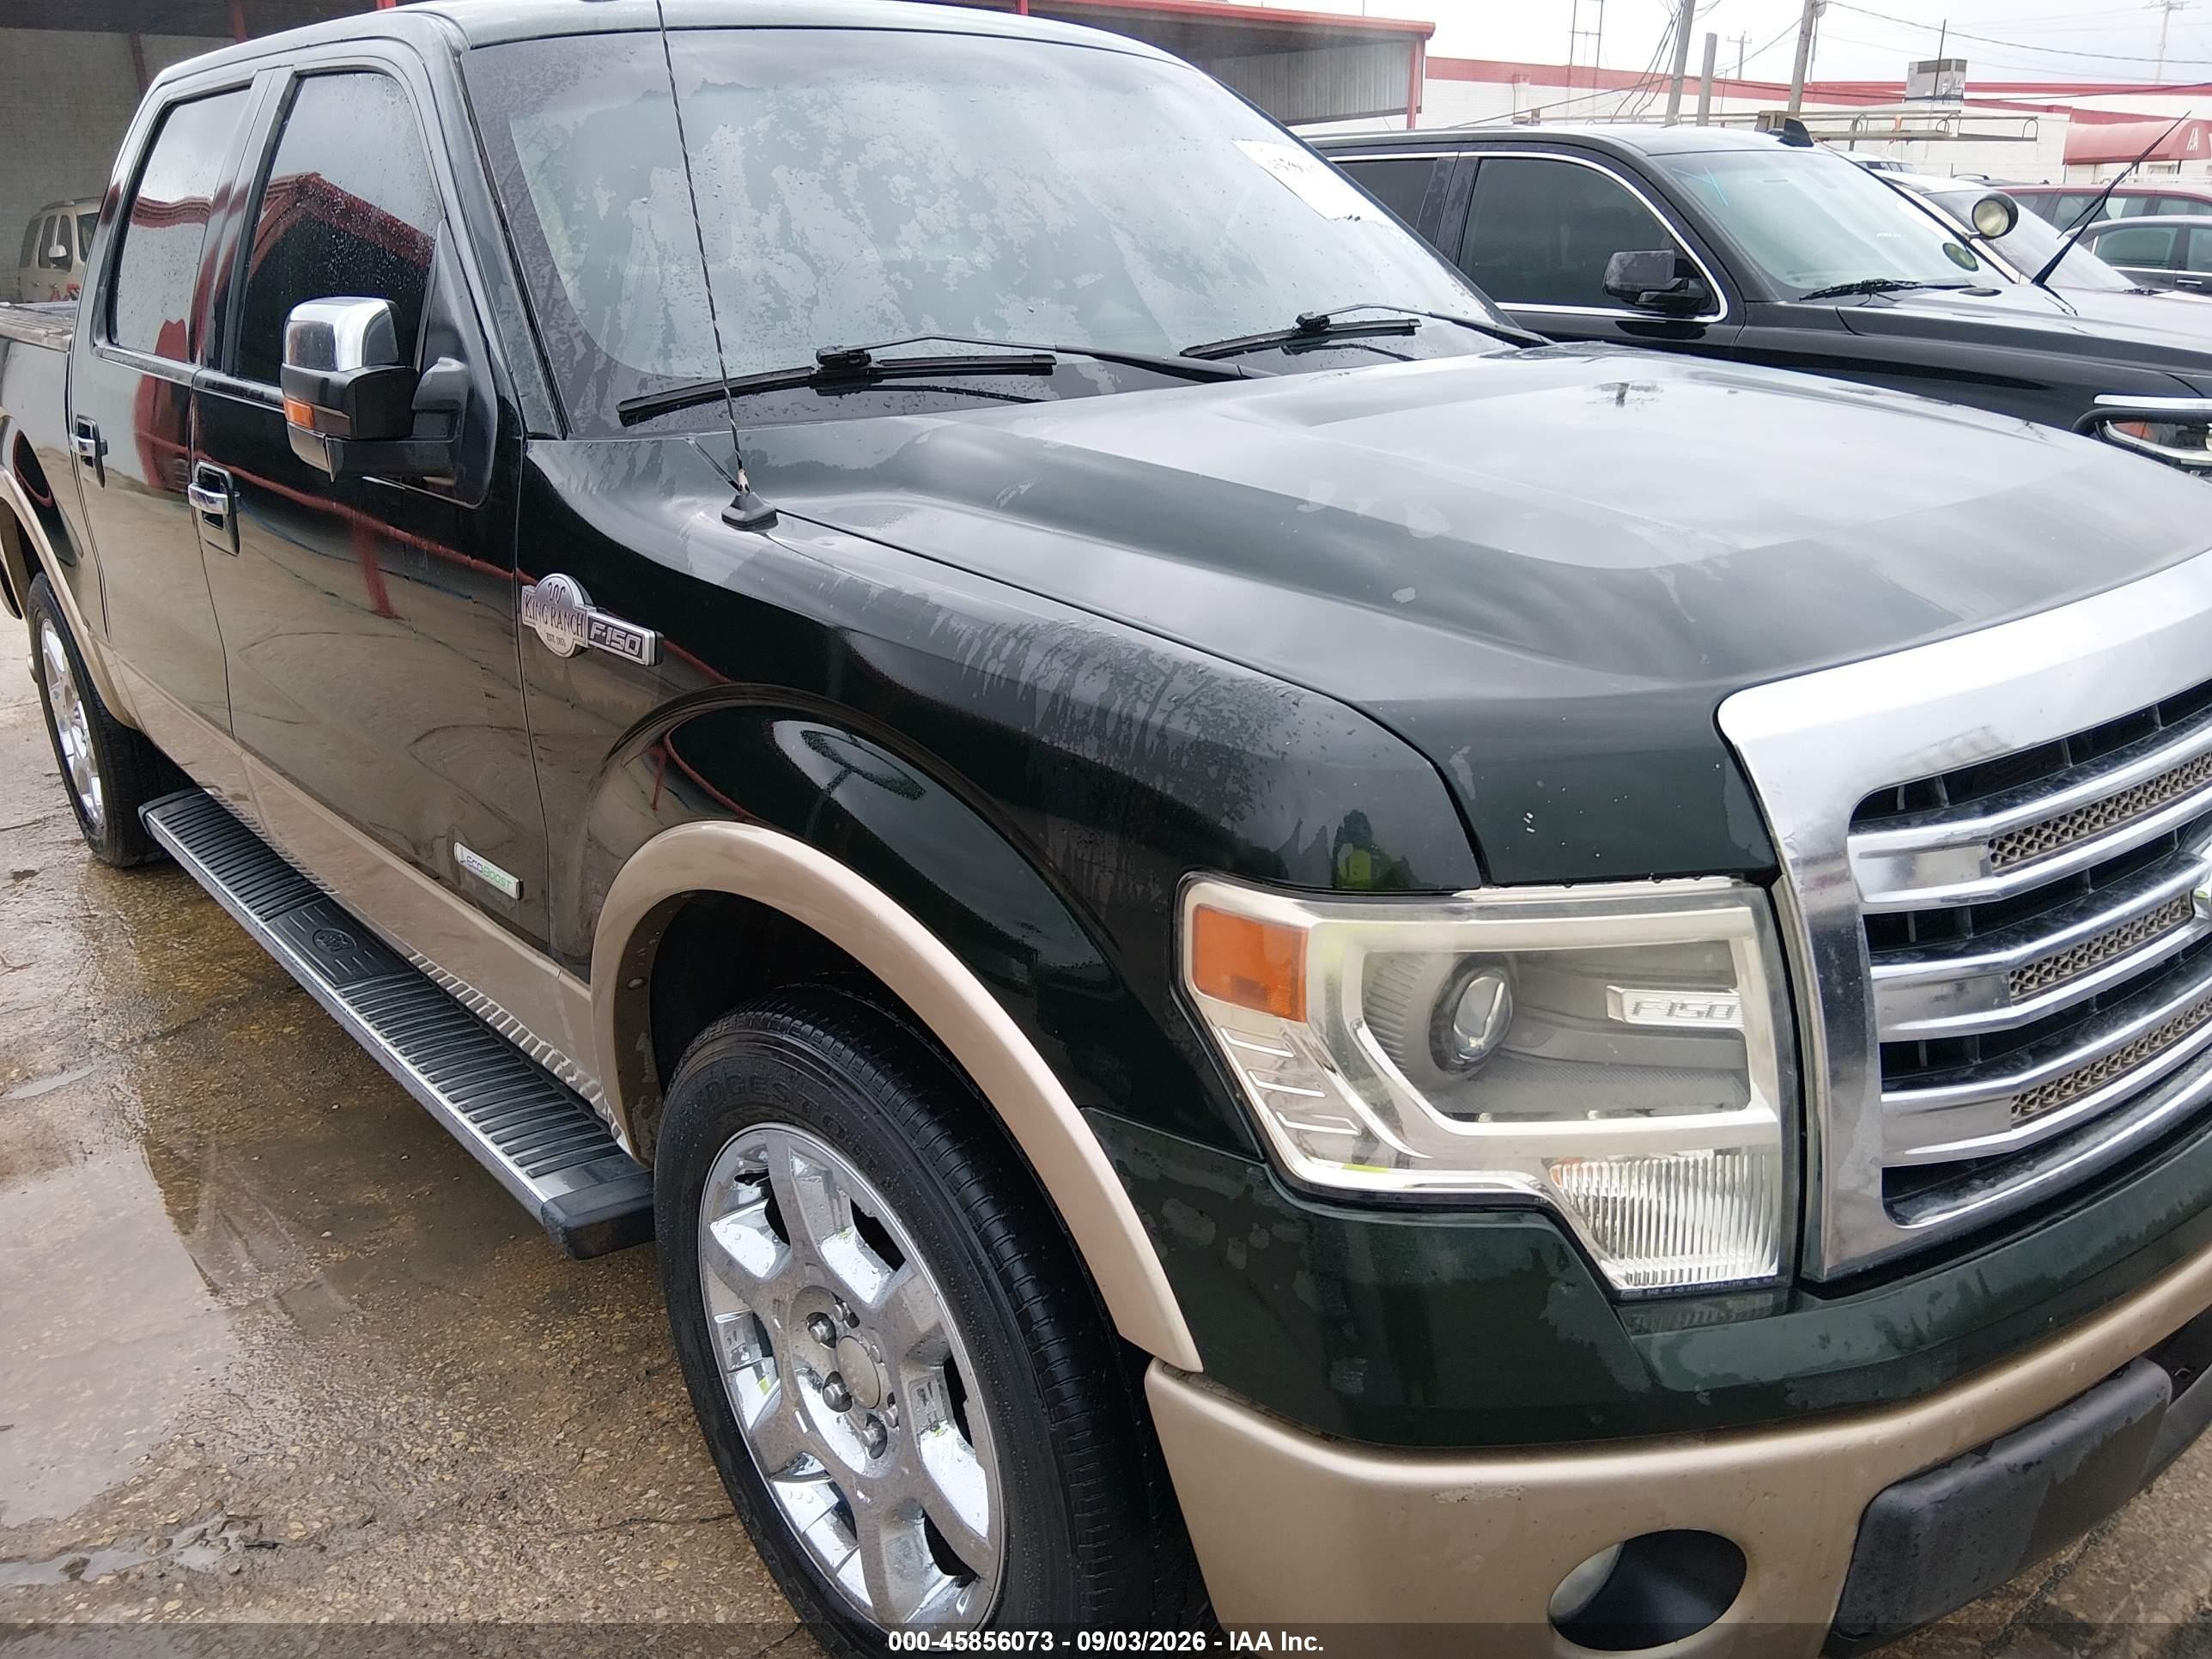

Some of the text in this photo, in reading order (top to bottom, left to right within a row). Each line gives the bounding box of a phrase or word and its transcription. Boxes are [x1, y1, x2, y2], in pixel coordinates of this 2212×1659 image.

[524, 593, 585, 638] KING RANCH
[590, 622, 641, 656] F-150
[466, 855, 512, 890] ECOBOOST
